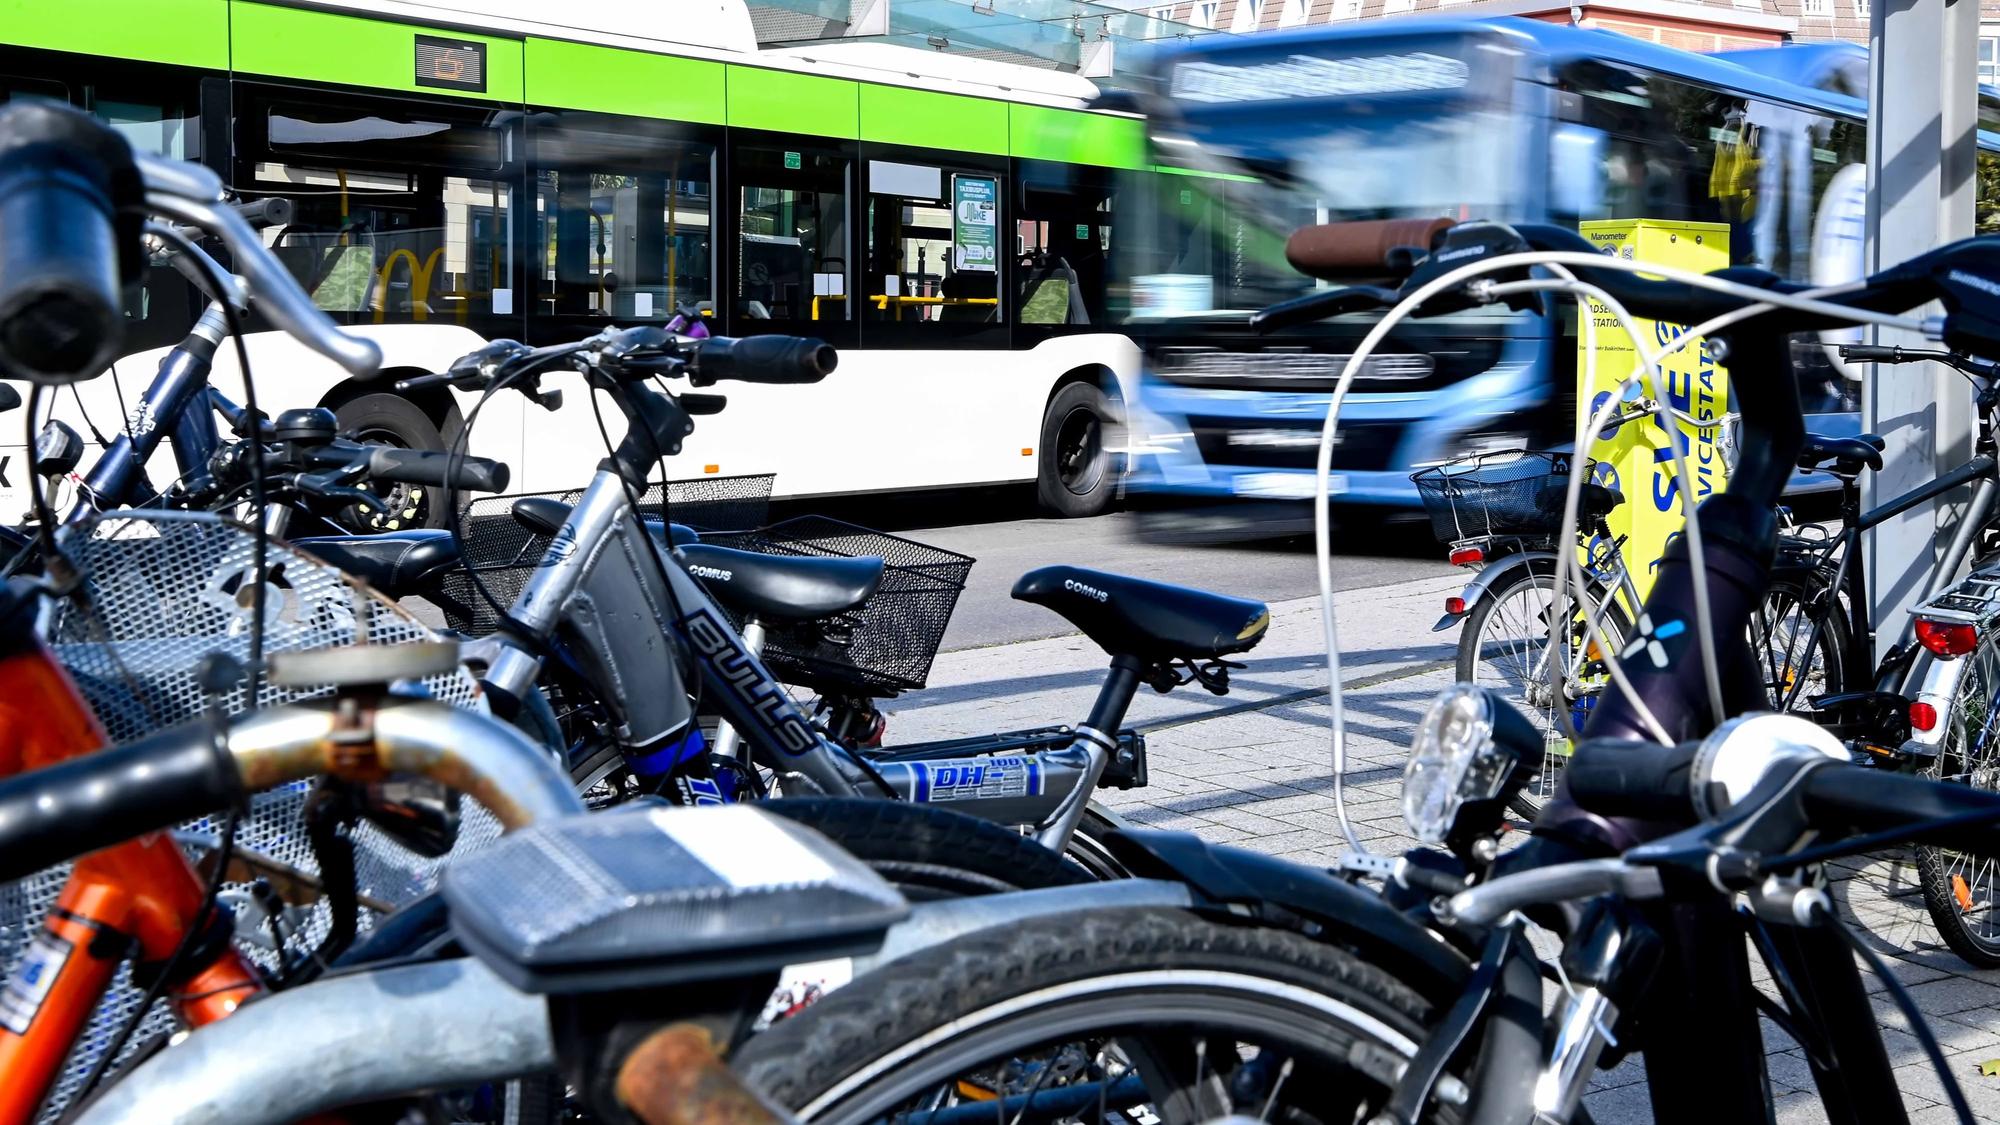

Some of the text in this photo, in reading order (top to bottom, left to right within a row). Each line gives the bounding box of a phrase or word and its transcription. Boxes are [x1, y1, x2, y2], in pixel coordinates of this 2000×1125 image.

[1591, 232, 1627, 240] Manometer
[689, 565, 733, 581] COMUS
[1065, 579, 1108, 602] COMUS
[686, 615, 815, 751] BULLS
